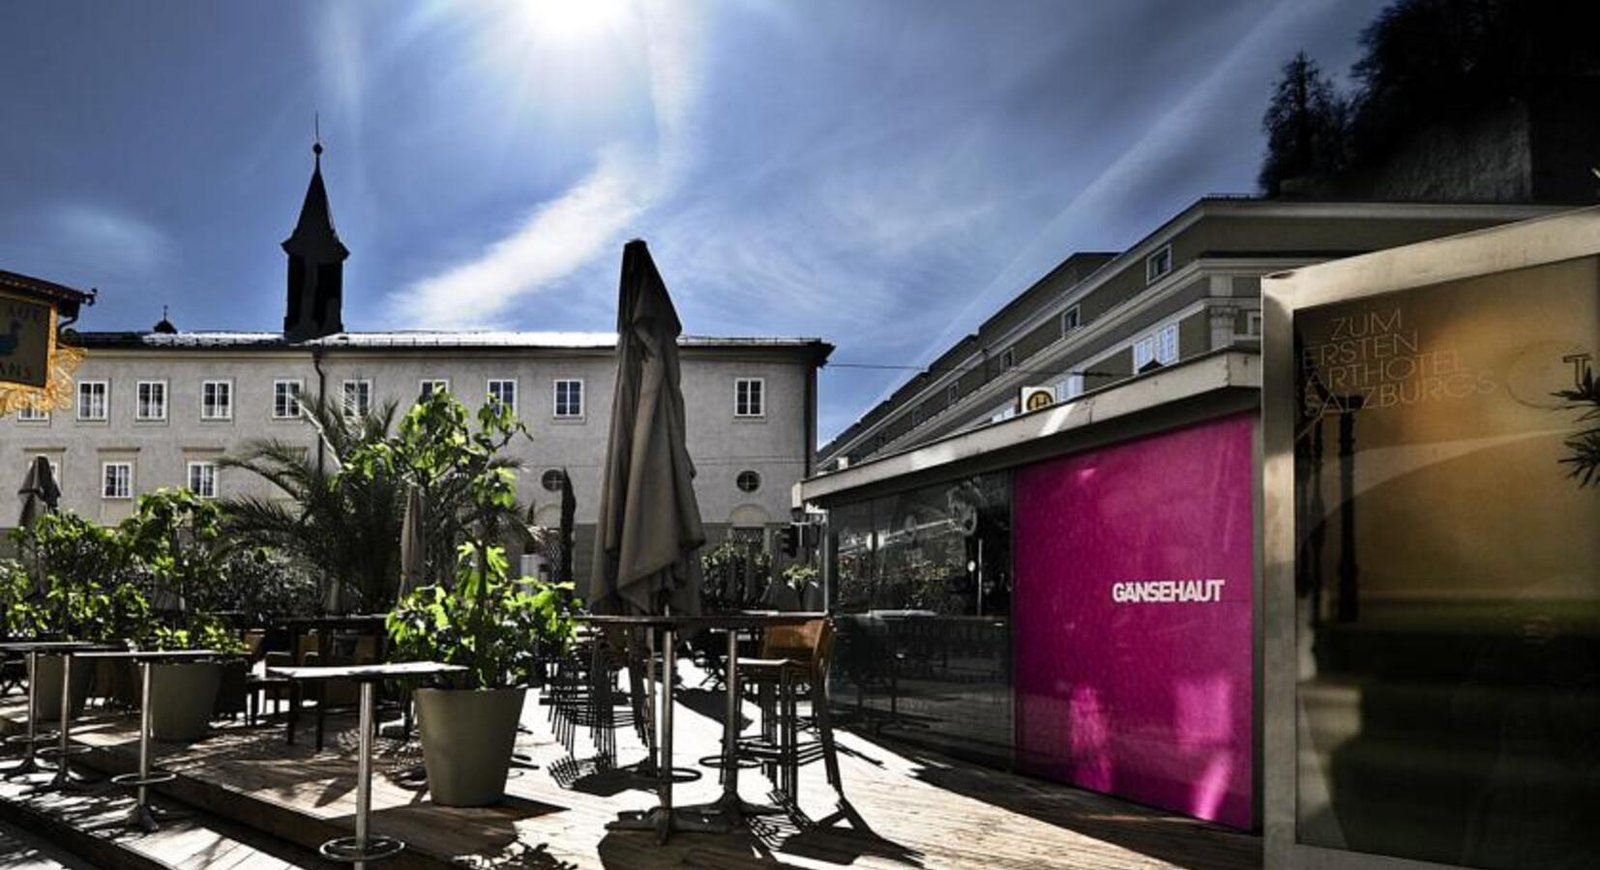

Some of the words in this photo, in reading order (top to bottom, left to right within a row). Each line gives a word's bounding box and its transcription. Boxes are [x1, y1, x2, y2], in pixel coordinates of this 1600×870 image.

[1331, 308, 1402, 341] ZUM
[1302, 329, 1418, 370] ERSTEN
[1303, 349, 1465, 389] ARTHOTEL
[1304, 370, 1496, 417] SALZBURGS
[1112, 579, 1225, 602] GÄNSEHAUT
